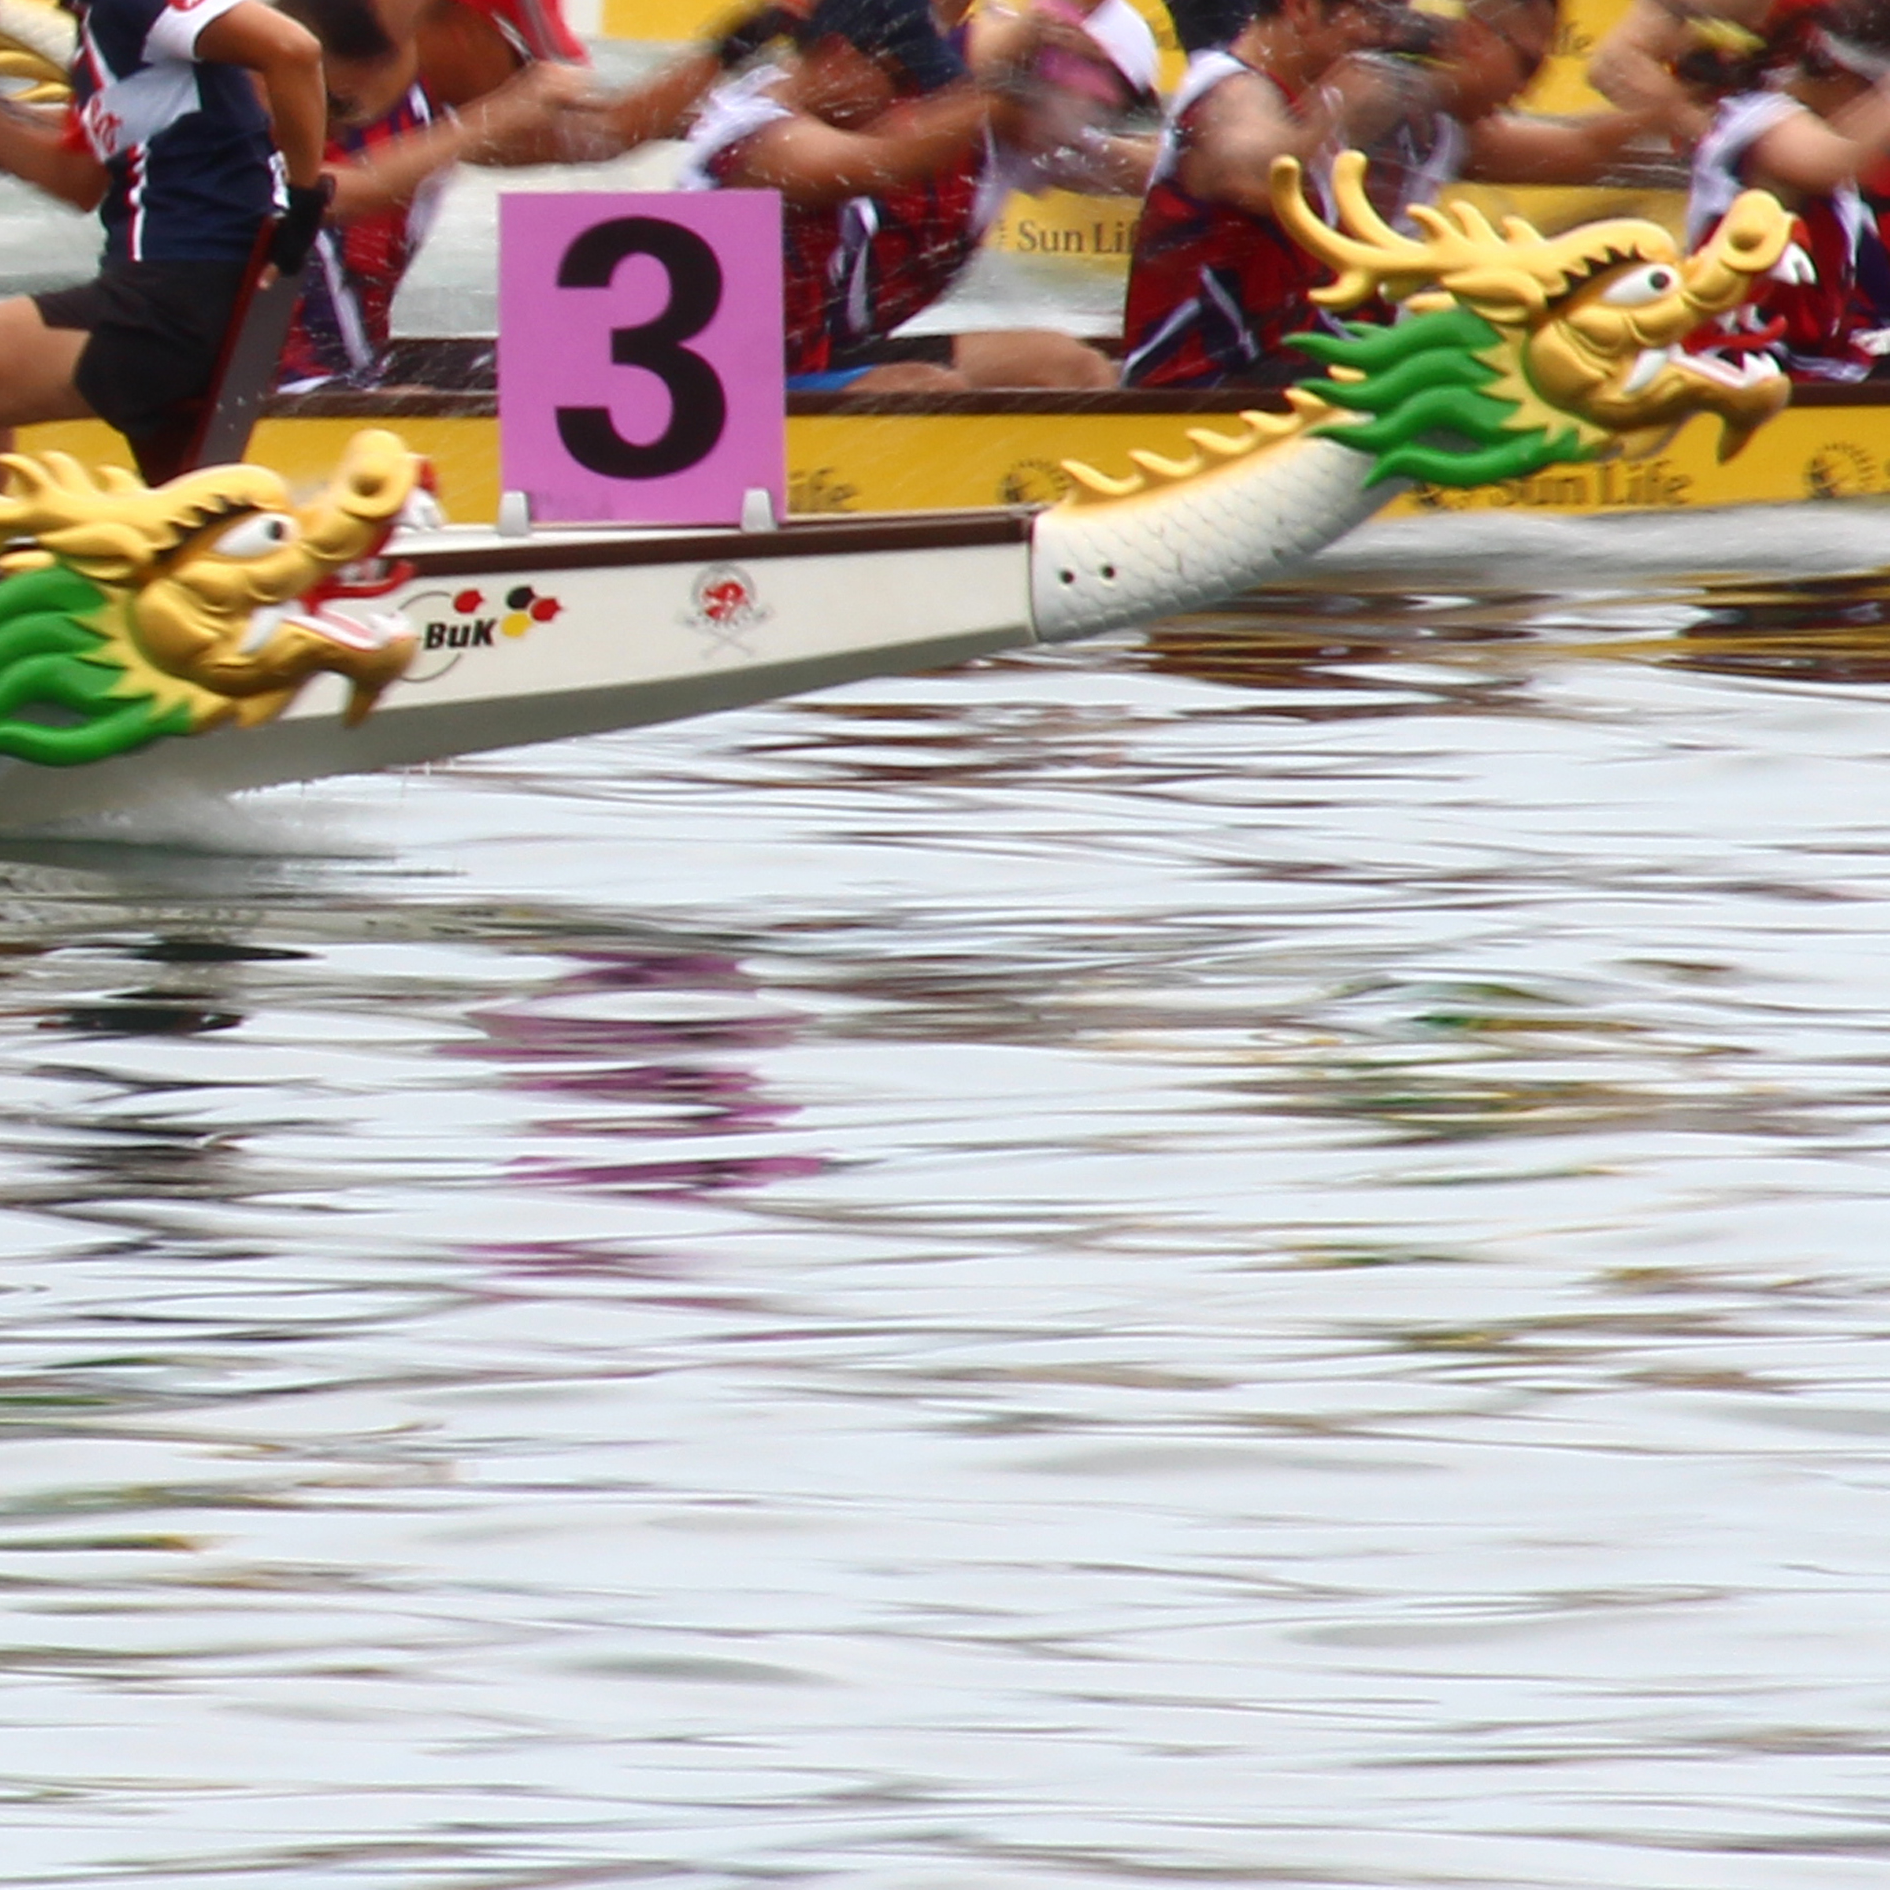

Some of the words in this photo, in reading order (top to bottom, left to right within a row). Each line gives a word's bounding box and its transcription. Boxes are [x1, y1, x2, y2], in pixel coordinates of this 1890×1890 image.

[1018, 220, 1083, 253] Sun
[1093, 220, 1138, 255] Li
[556, 216, 725, 480] 3
